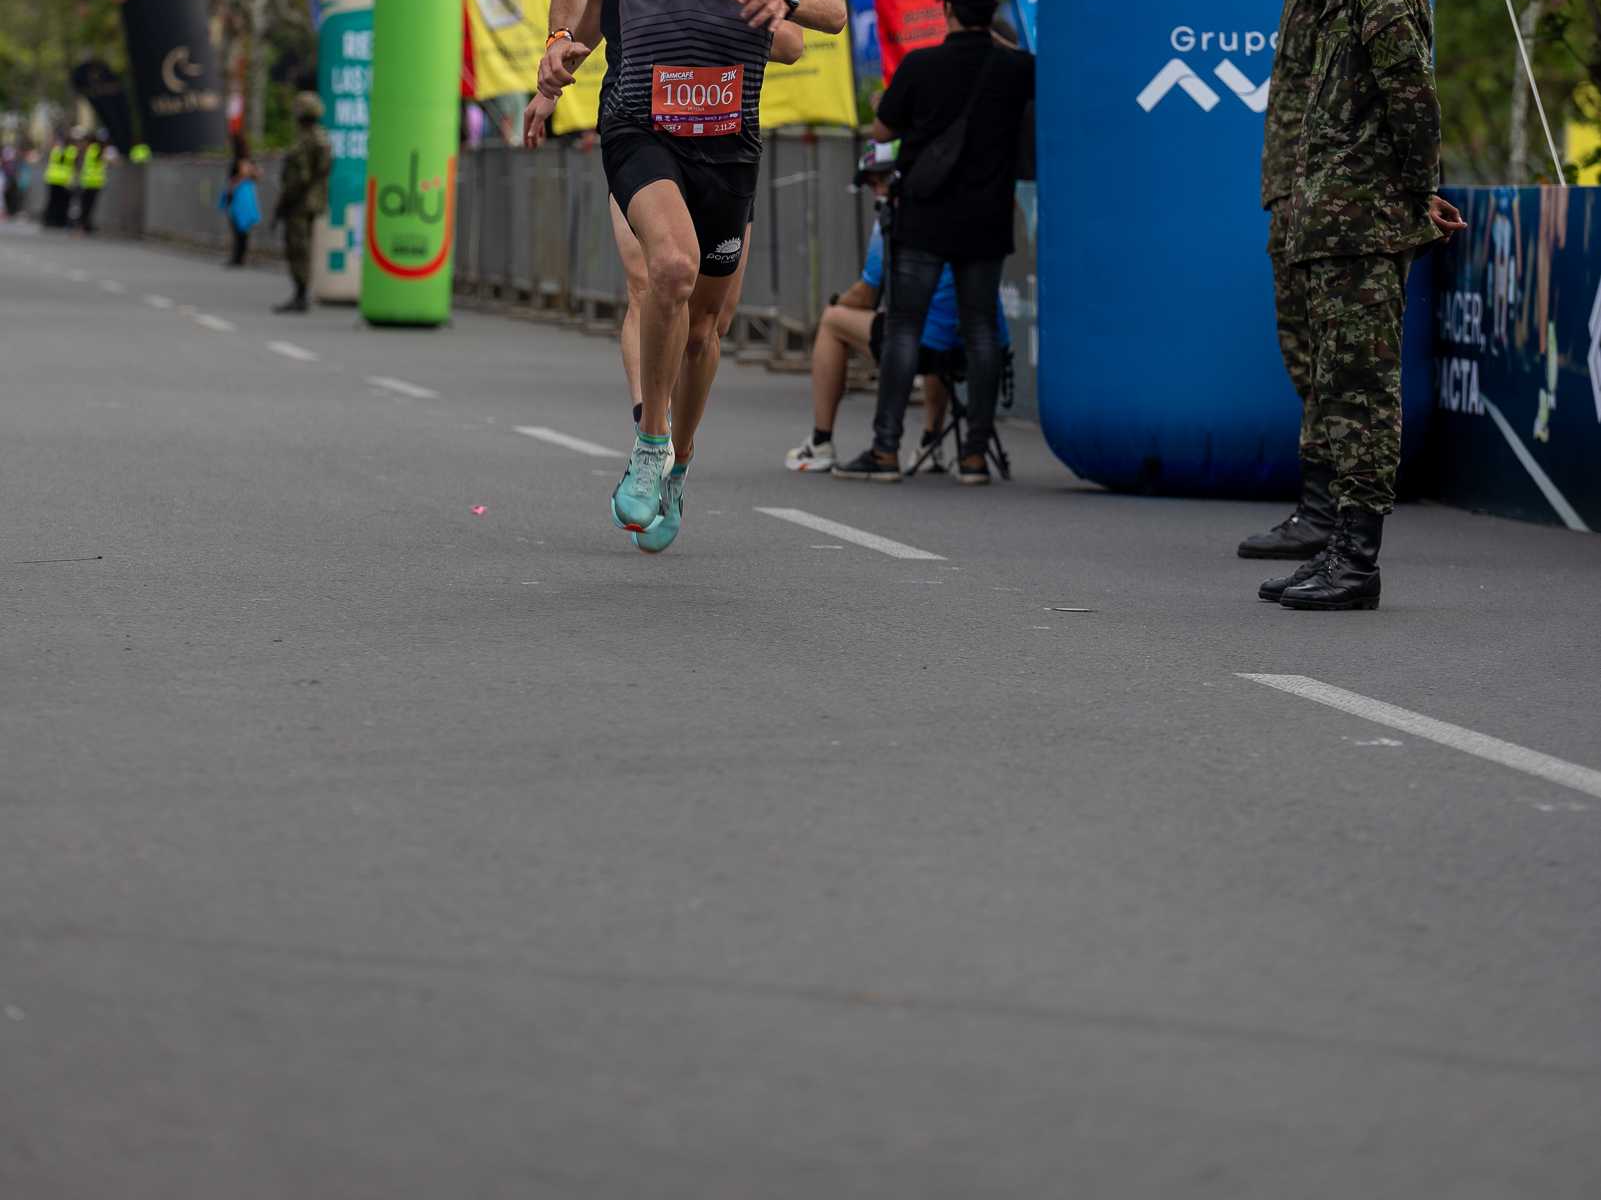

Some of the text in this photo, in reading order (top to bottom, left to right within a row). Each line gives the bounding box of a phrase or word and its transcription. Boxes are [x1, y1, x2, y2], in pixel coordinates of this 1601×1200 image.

[662, 82, 734, 106] 10006
[720, 70, 737, 82] 21K
[1438, 291, 1487, 352] ACER,
[1436, 355, 1485, 416] ACTA.
